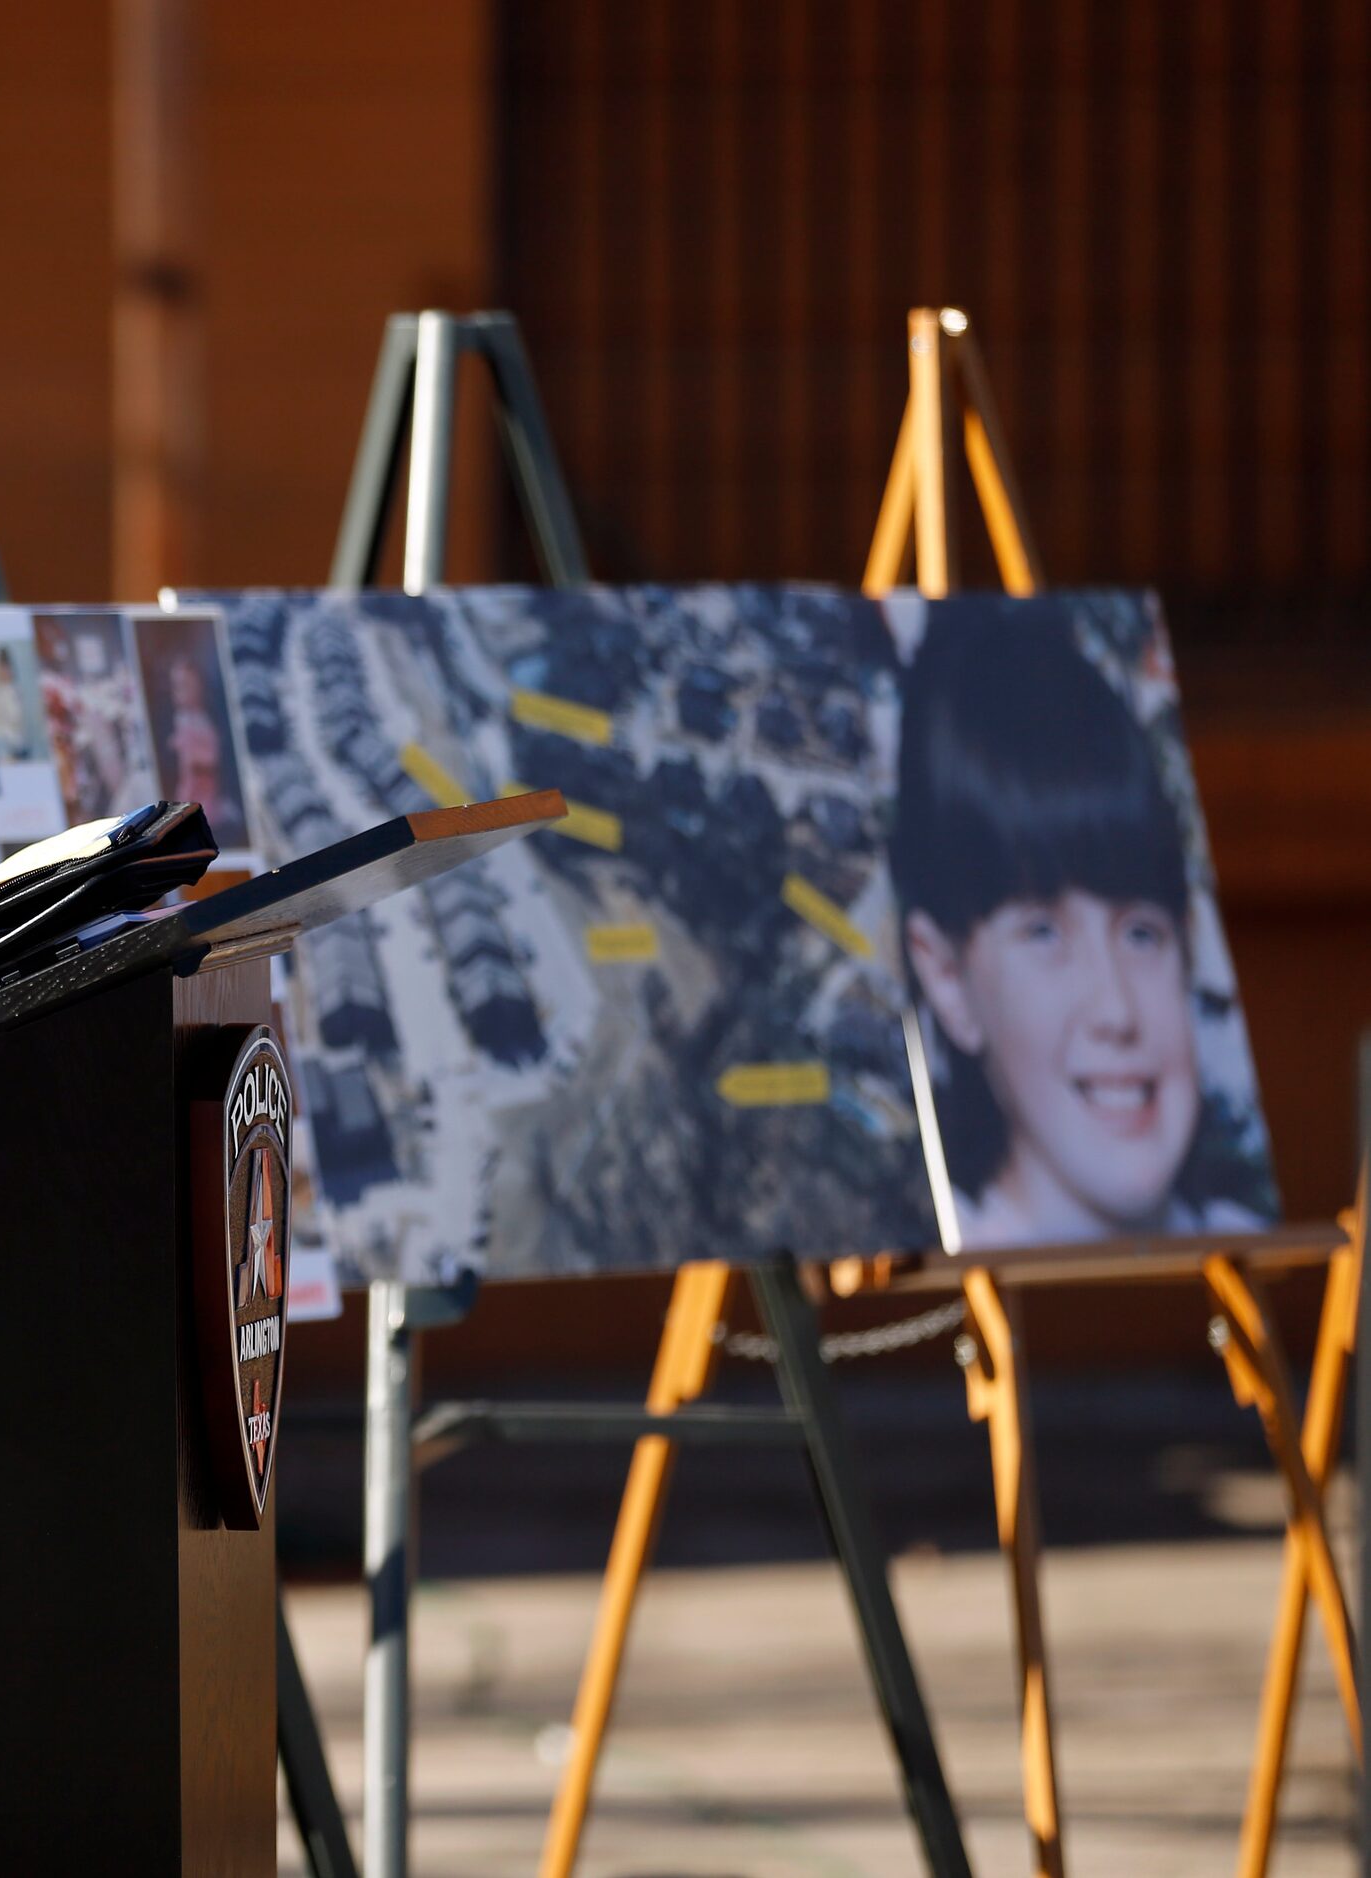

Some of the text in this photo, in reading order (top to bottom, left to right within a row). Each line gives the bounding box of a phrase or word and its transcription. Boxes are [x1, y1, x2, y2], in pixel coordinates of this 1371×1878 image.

[231, 1063, 287, 1159] POLICE
[239, 1315, 280, 1363] ARLINGTON
[248, 1410, 271, 1444] TEXAS
